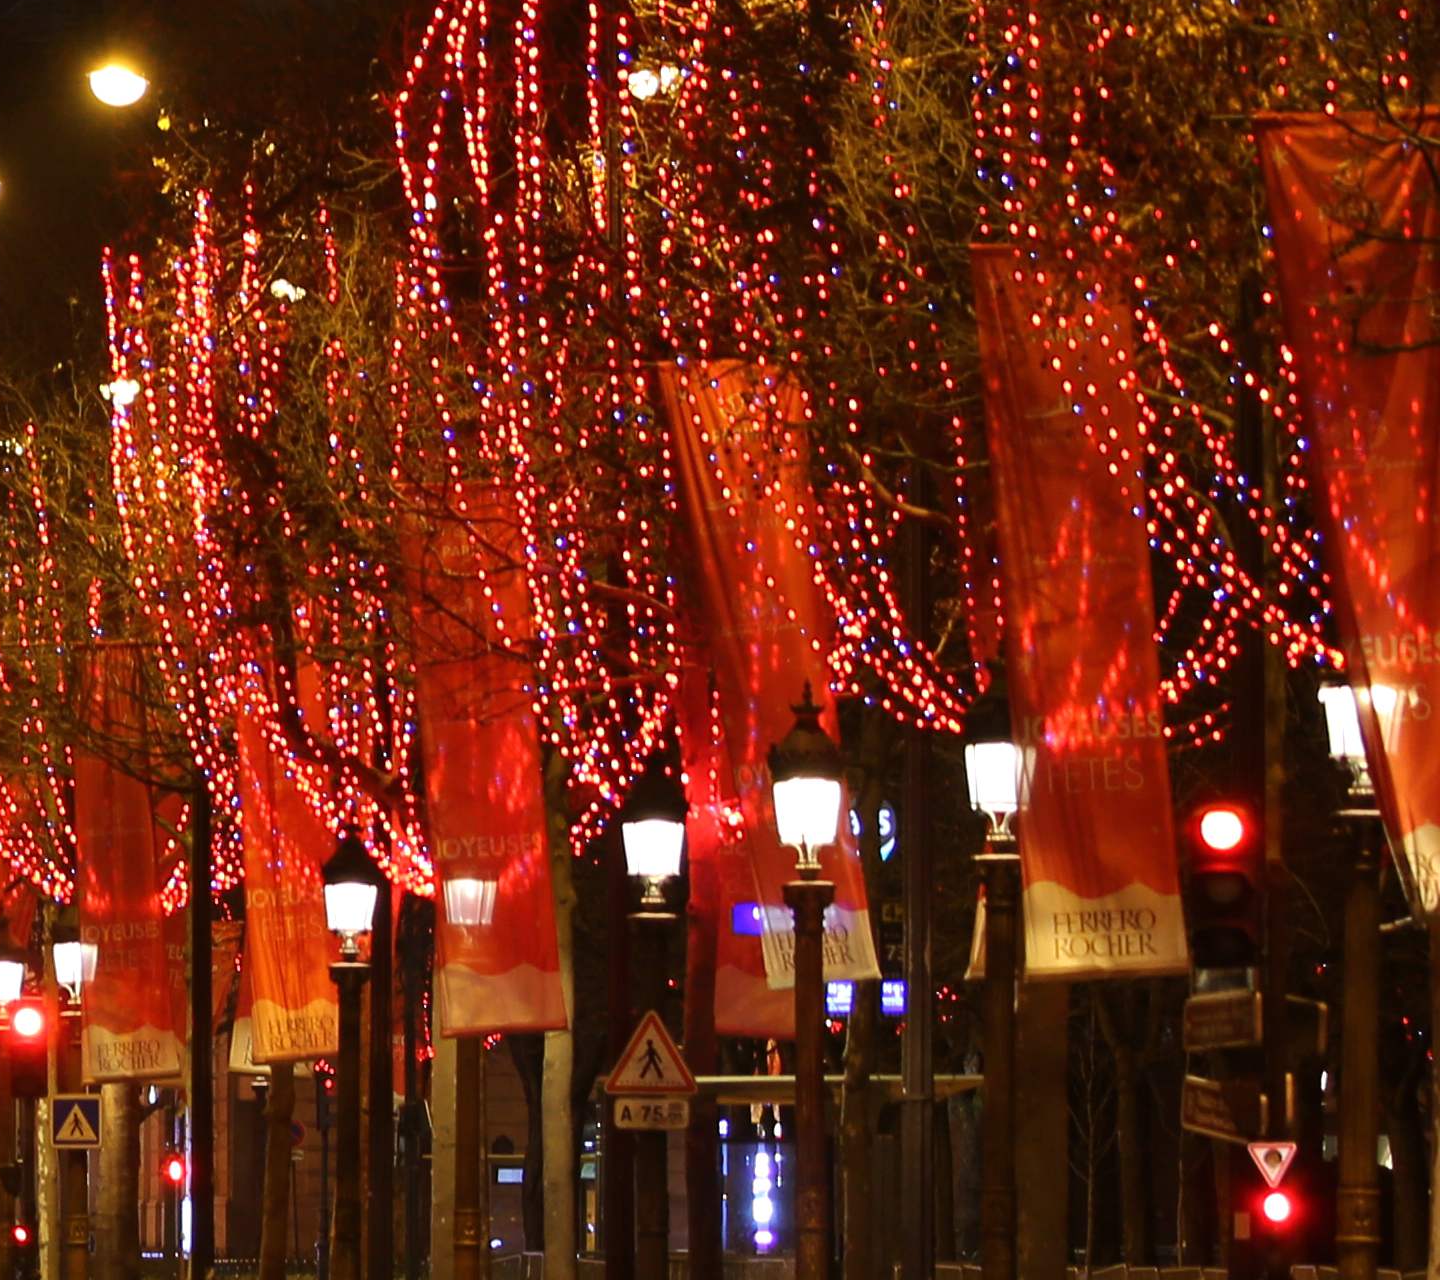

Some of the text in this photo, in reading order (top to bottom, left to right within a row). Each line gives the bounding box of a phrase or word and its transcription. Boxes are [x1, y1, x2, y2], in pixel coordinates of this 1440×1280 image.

[1053, 907, 1157, 935] FERRERO
[1054, 933, 1158, 961] ROCHER
[621, 1105, 632, 1122] A
[641, 1105, 663, 1122] 75
